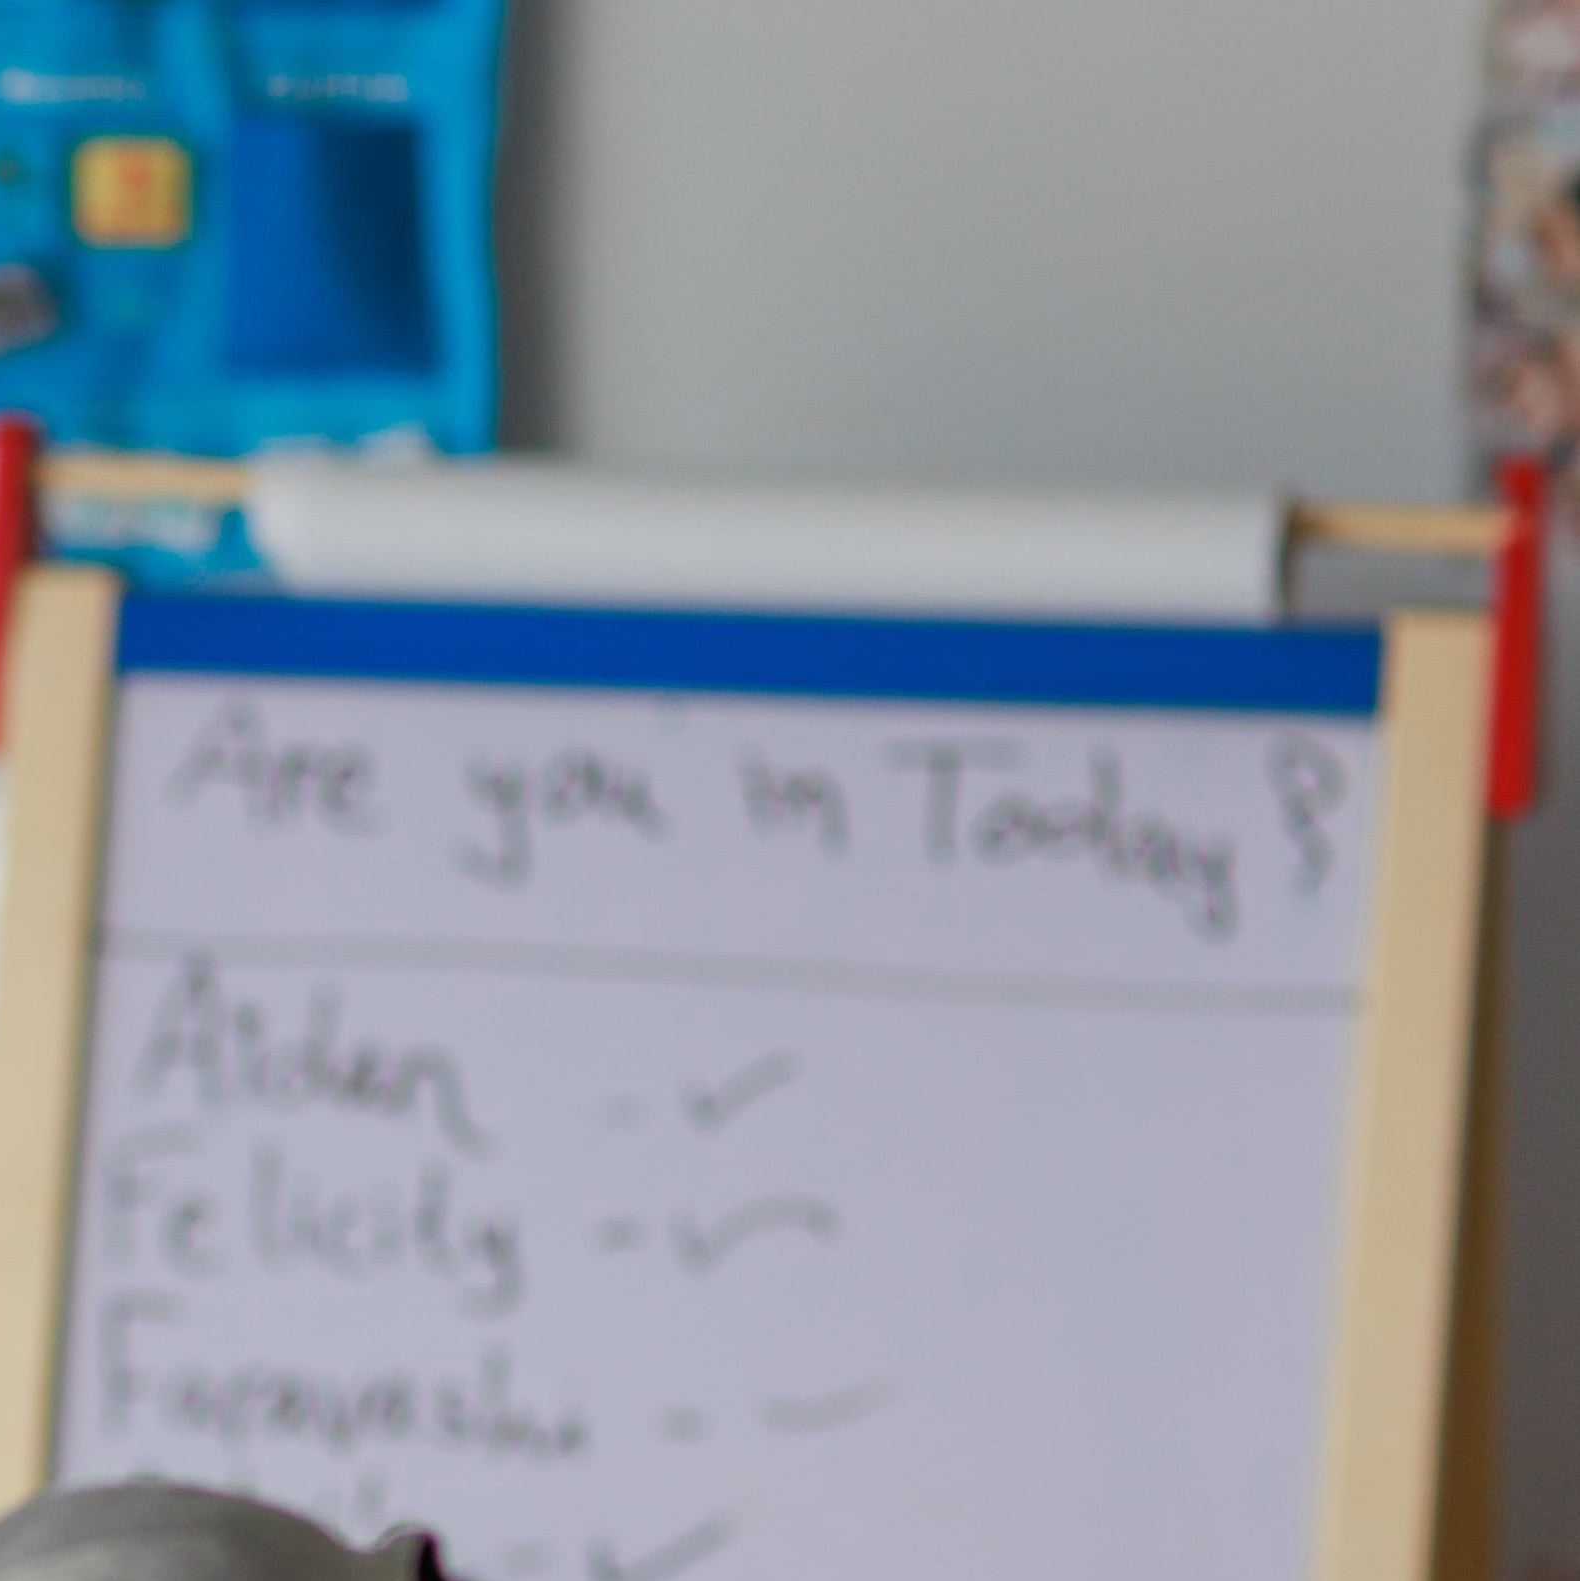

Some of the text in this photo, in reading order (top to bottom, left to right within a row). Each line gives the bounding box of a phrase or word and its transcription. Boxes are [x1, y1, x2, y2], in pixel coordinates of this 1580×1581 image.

[161, 692, 389, 838] Are
[447, 745, 671, 892] you
[736, 742, 853, 862] in
[105, 1126, 527, 1318] Felicity
